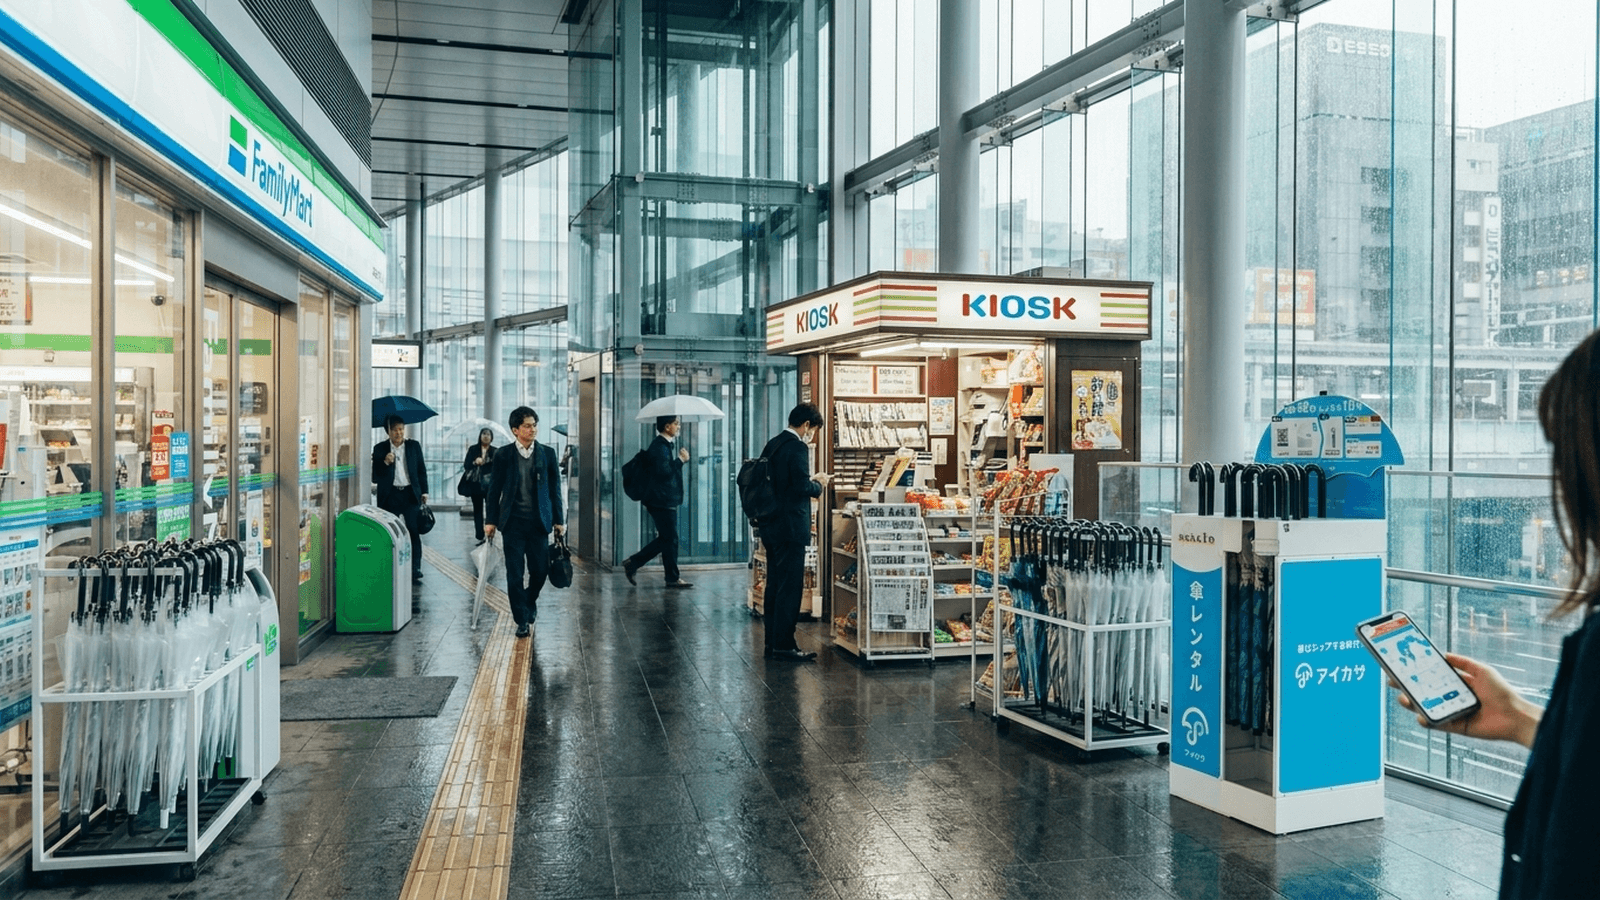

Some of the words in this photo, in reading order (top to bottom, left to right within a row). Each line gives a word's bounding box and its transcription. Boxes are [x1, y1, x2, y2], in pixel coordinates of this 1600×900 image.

[251, 139, 313, 228] FamilyMart
[796, 301, 839, 335] KIOSK
[962, 292, 1077, 321] KIOSK
